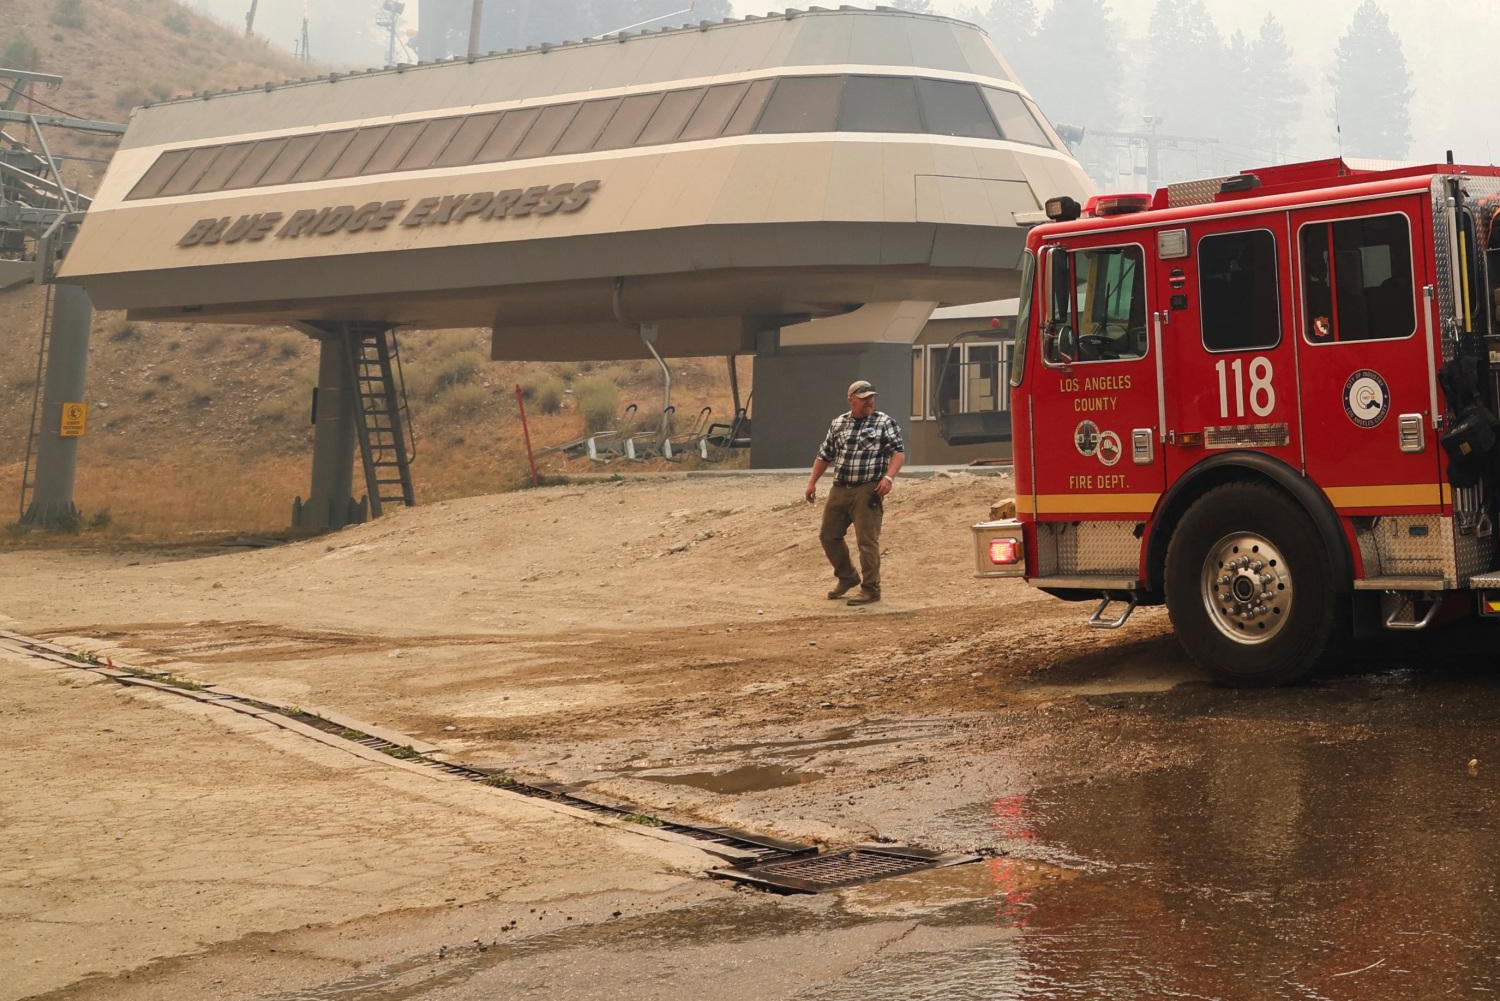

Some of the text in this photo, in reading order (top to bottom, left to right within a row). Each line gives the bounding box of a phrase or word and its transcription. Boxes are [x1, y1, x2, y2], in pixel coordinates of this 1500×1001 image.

[176, 179, 601, 247] BLUE RIDGE EXPRESS
[1060, 375, 1132, 392] LOS ANGELES
[1215, 356, 1276, 418] 118
[1074, 396, 1117, 412] COUNTY
[1069, 474, 1131, 489] FIRE DEPT.
